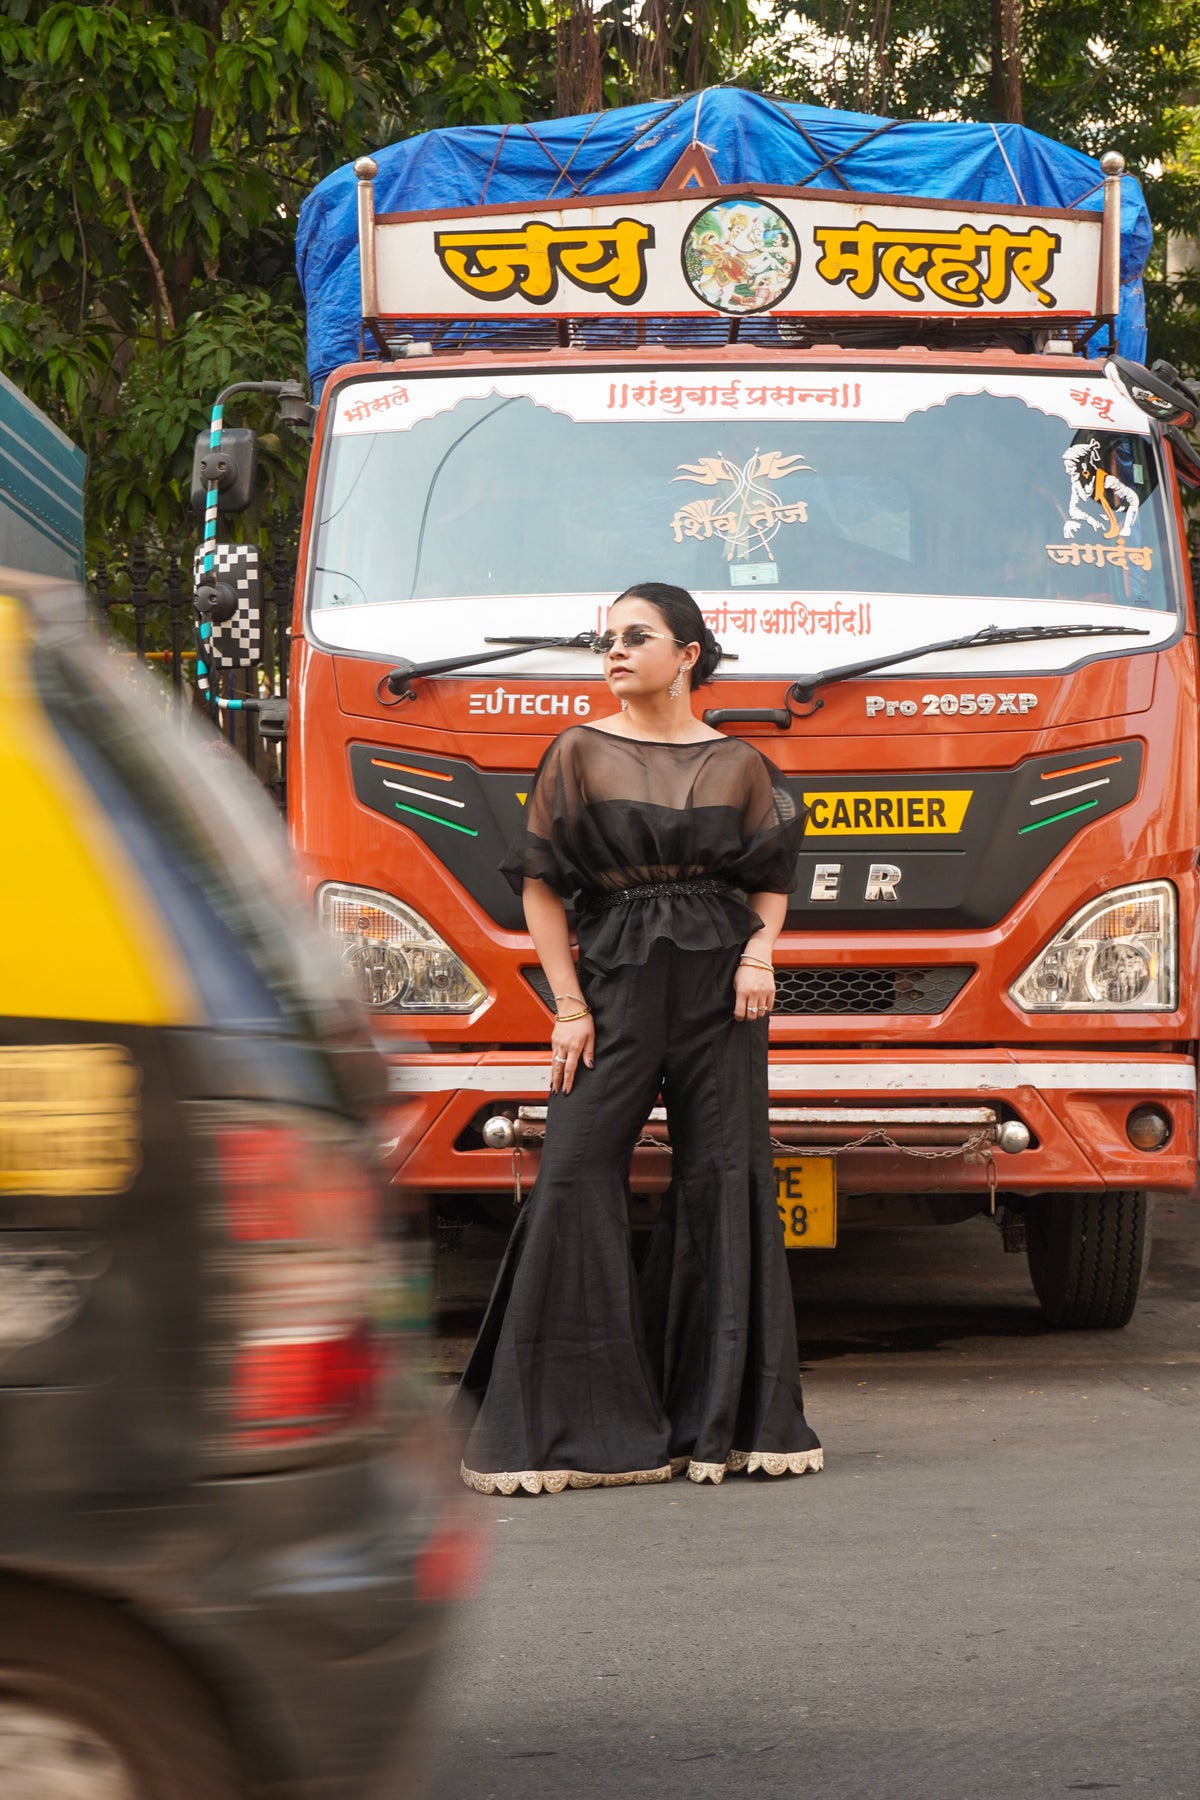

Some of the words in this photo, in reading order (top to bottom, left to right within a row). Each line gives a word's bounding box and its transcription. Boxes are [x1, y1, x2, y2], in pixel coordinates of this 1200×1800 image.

[434, 217, 656, 306] जय
[813, 220, 1061, 308] मल्हार
[344, 385, 410, 422] भोसले
[1069, 387, 1115, 422] बंधू
[669, 498, 737, 544] शिव
[746, 501, 808, 531] तेज
[1045, 537, 1153, 571] जगदंब
[865, 695, 918, 717] Pro
[921, 693, 1038, 716] 2059XP
[810, 797, 947, 829] CARRIER
